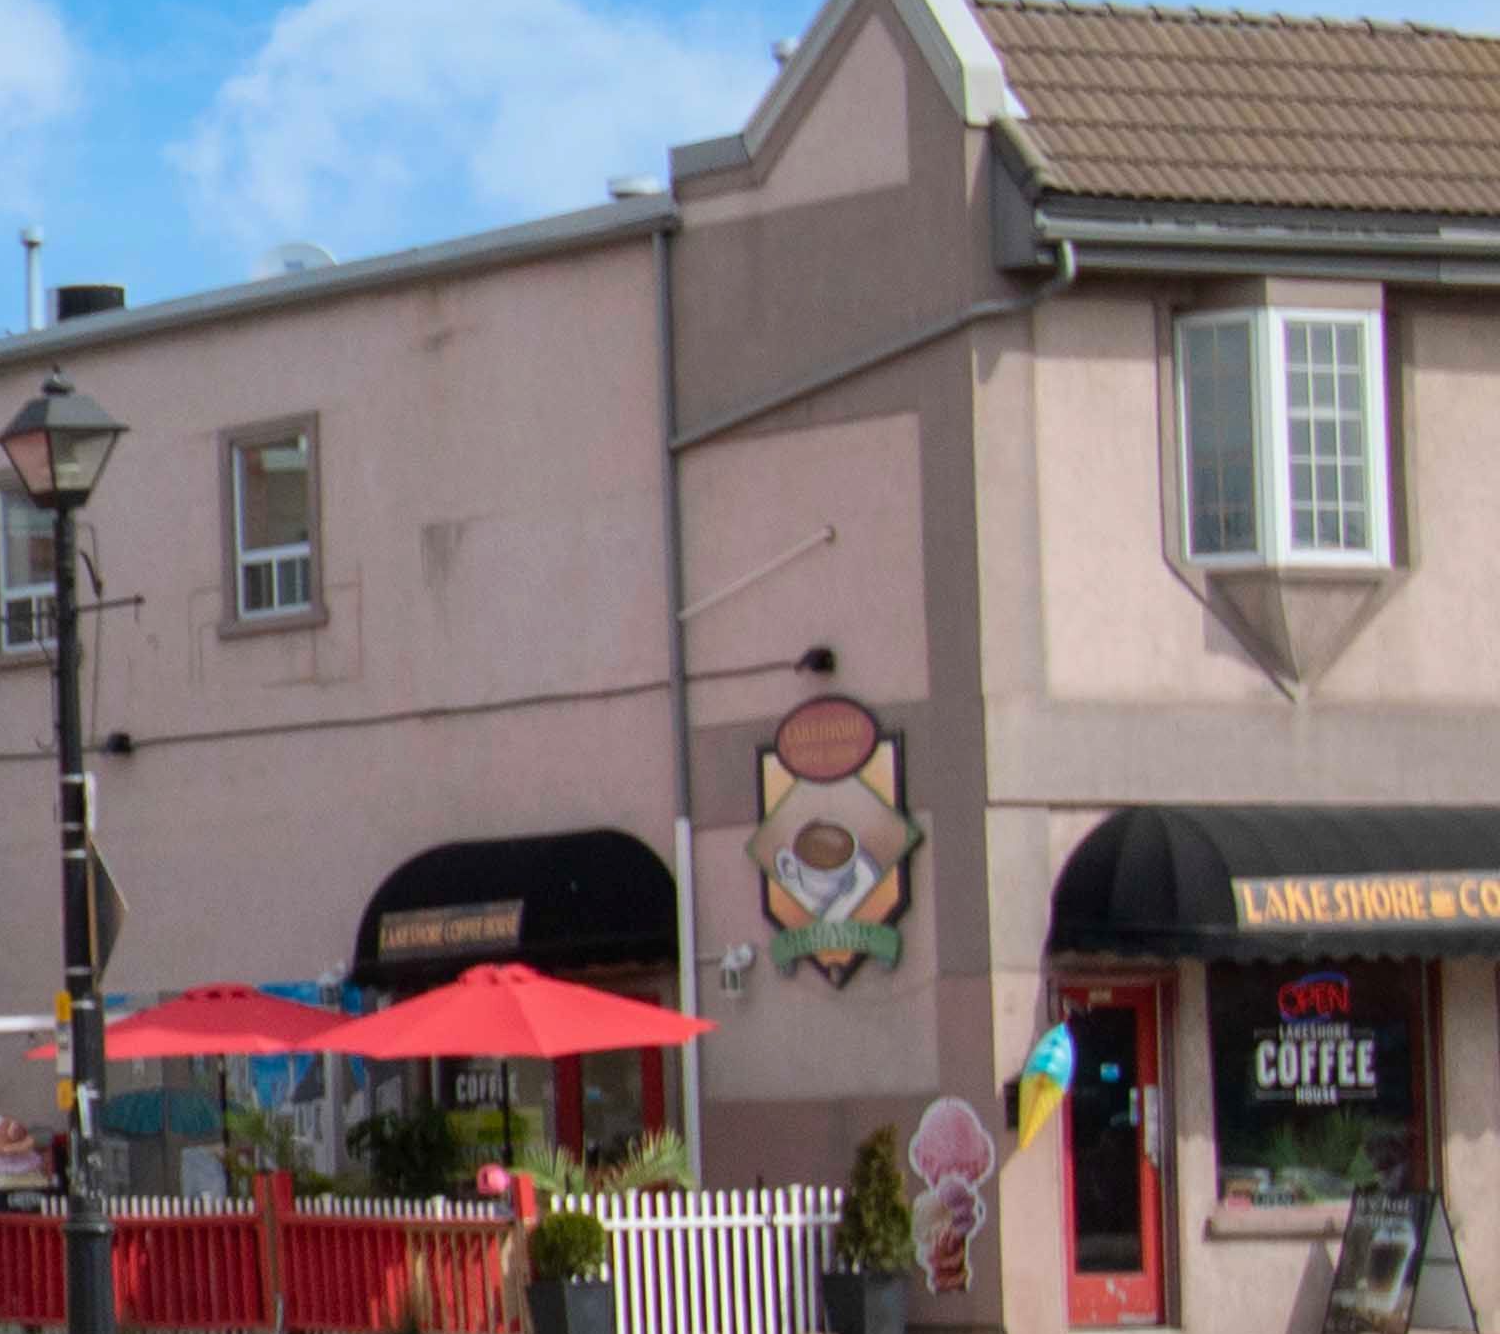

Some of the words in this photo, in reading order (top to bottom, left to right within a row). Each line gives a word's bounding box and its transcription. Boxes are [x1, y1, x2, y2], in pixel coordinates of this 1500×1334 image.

[1277, 980, 1351, 1015] OPEN
[1255, 1039, 1376, 1089] COFFEE
[1295, 1086, 1338, 1106] HOUSE
